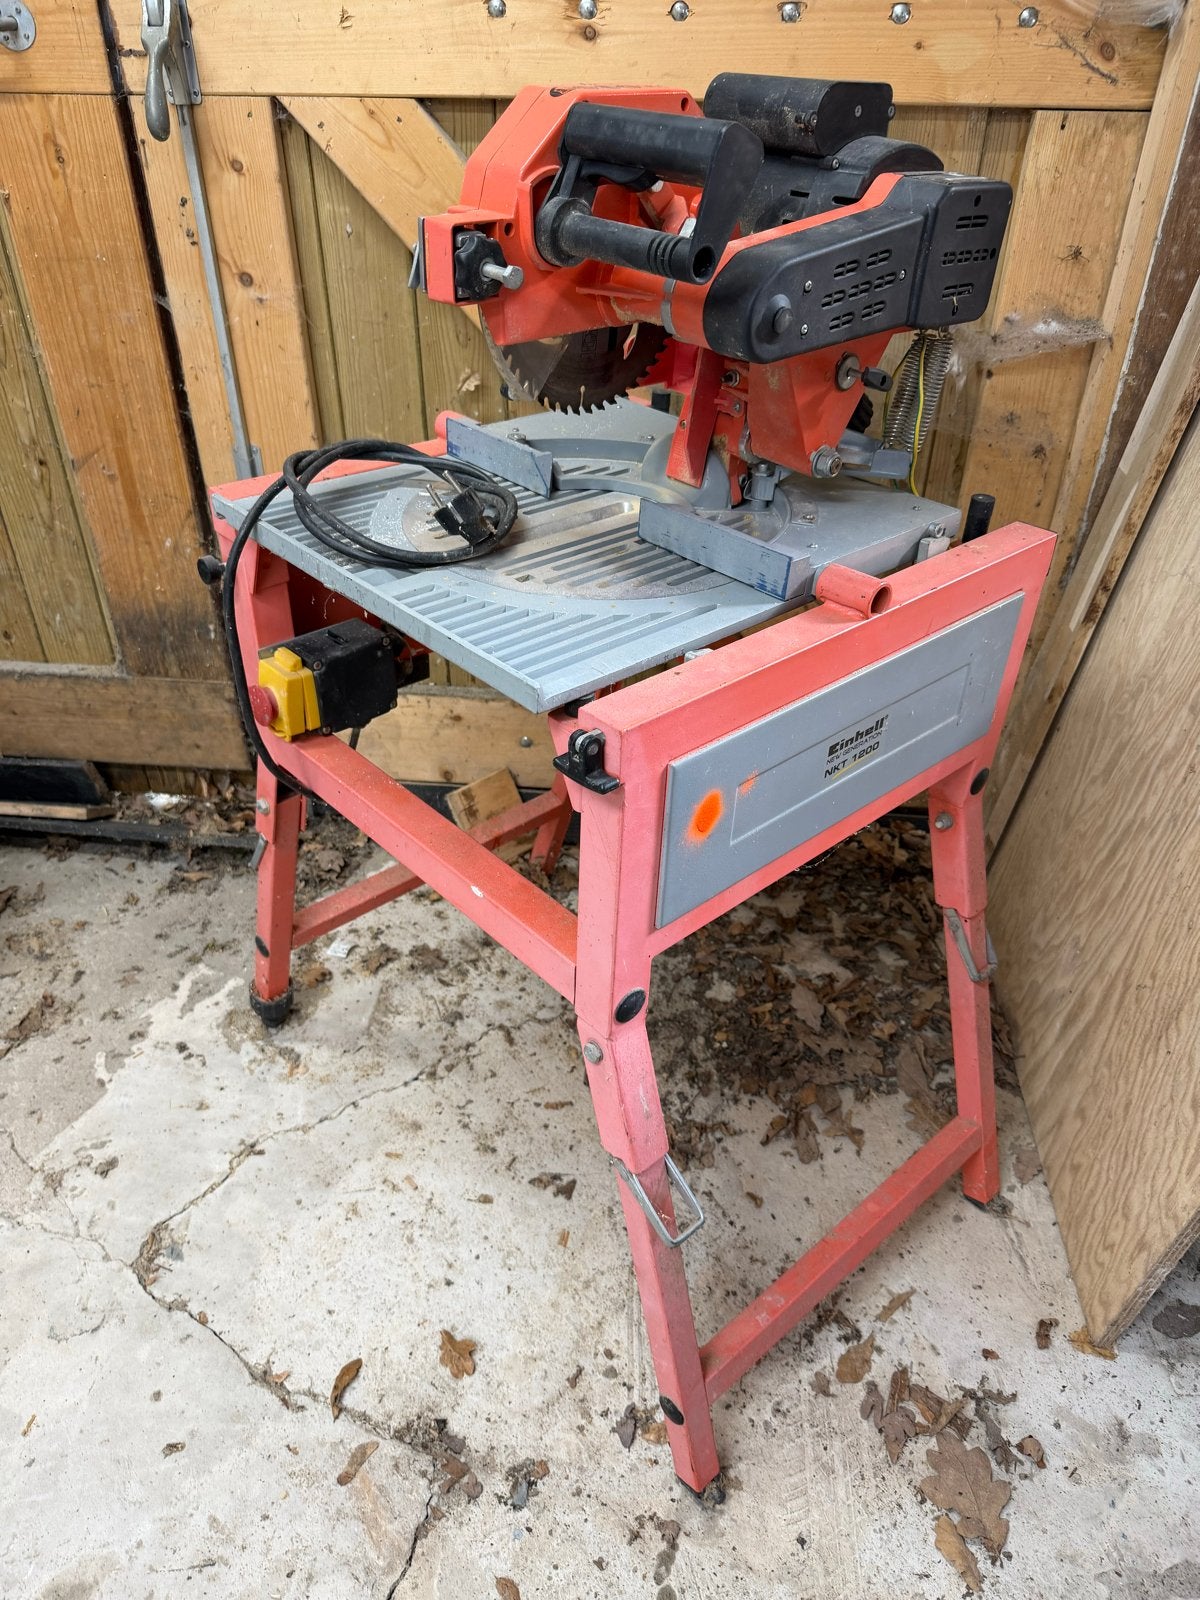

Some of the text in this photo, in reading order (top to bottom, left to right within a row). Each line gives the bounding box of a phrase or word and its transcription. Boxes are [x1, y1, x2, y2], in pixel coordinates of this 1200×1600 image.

[824, 741, 880, 778] NKT 1200
[826, 730, 883, 765] NEW GENERATION
